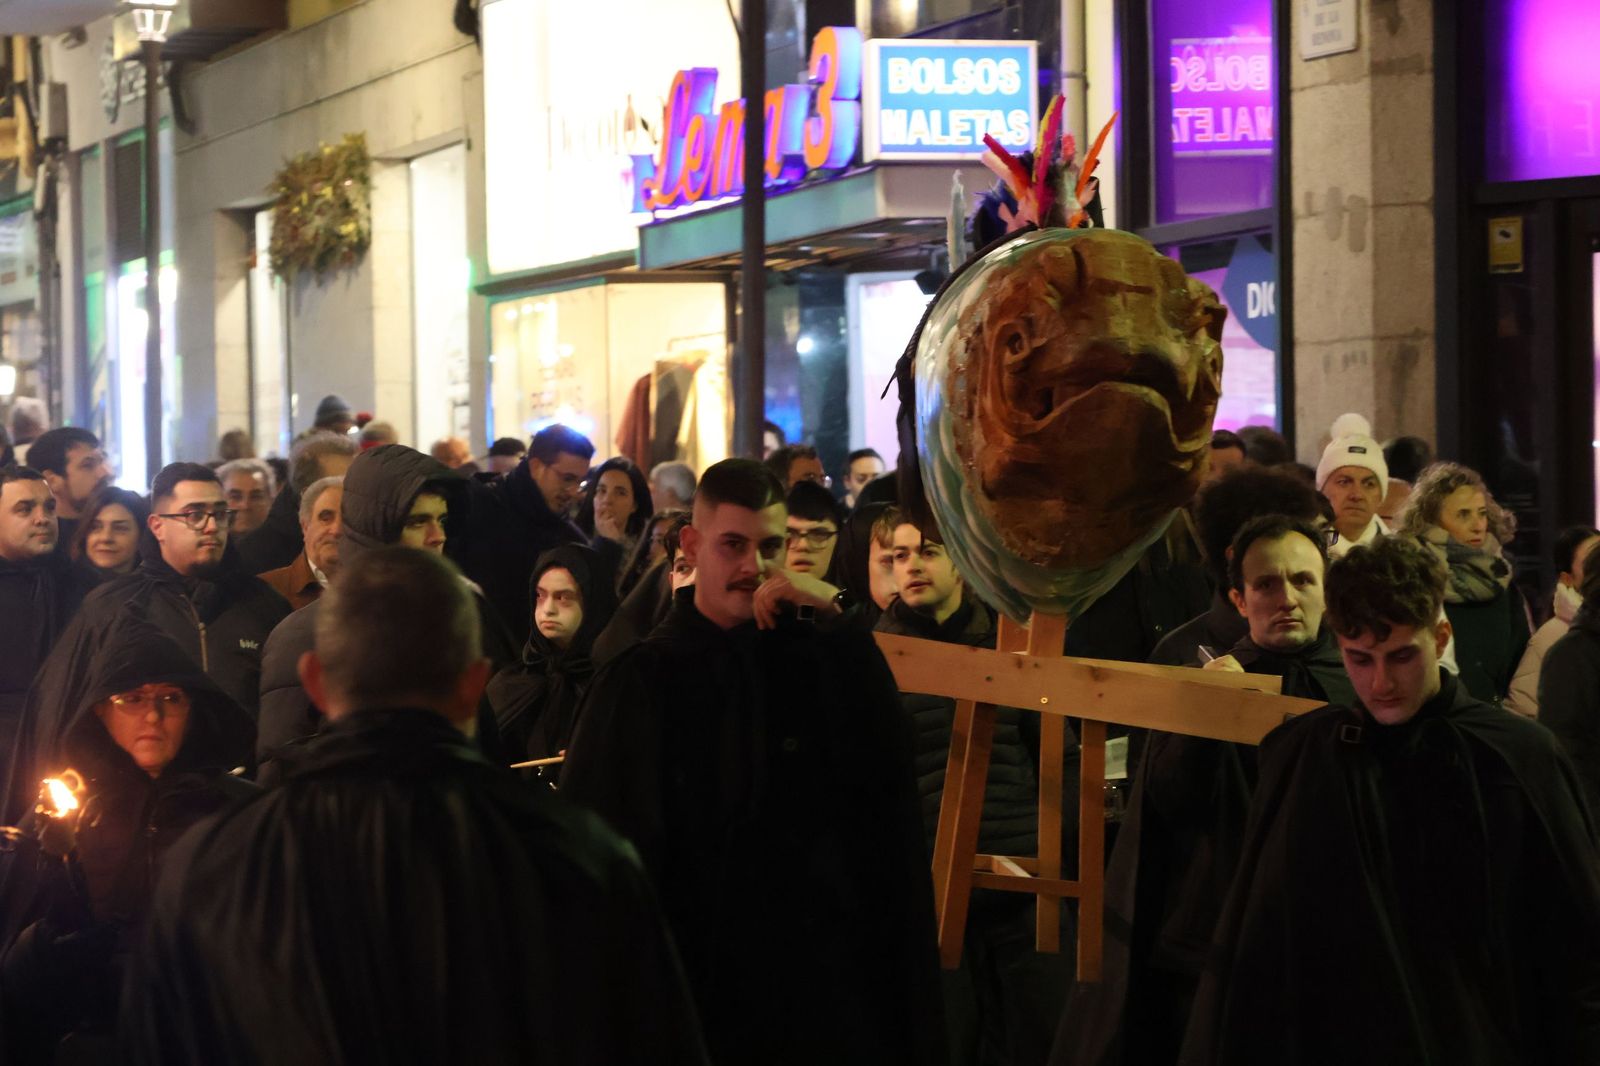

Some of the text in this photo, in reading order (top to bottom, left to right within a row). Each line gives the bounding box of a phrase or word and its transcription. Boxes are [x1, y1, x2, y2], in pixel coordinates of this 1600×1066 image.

[888, 57, 1021, 95] BOLSOS
[804, 26, 848, 169] 3
[881, 109, 1030, 146] MALETAS
